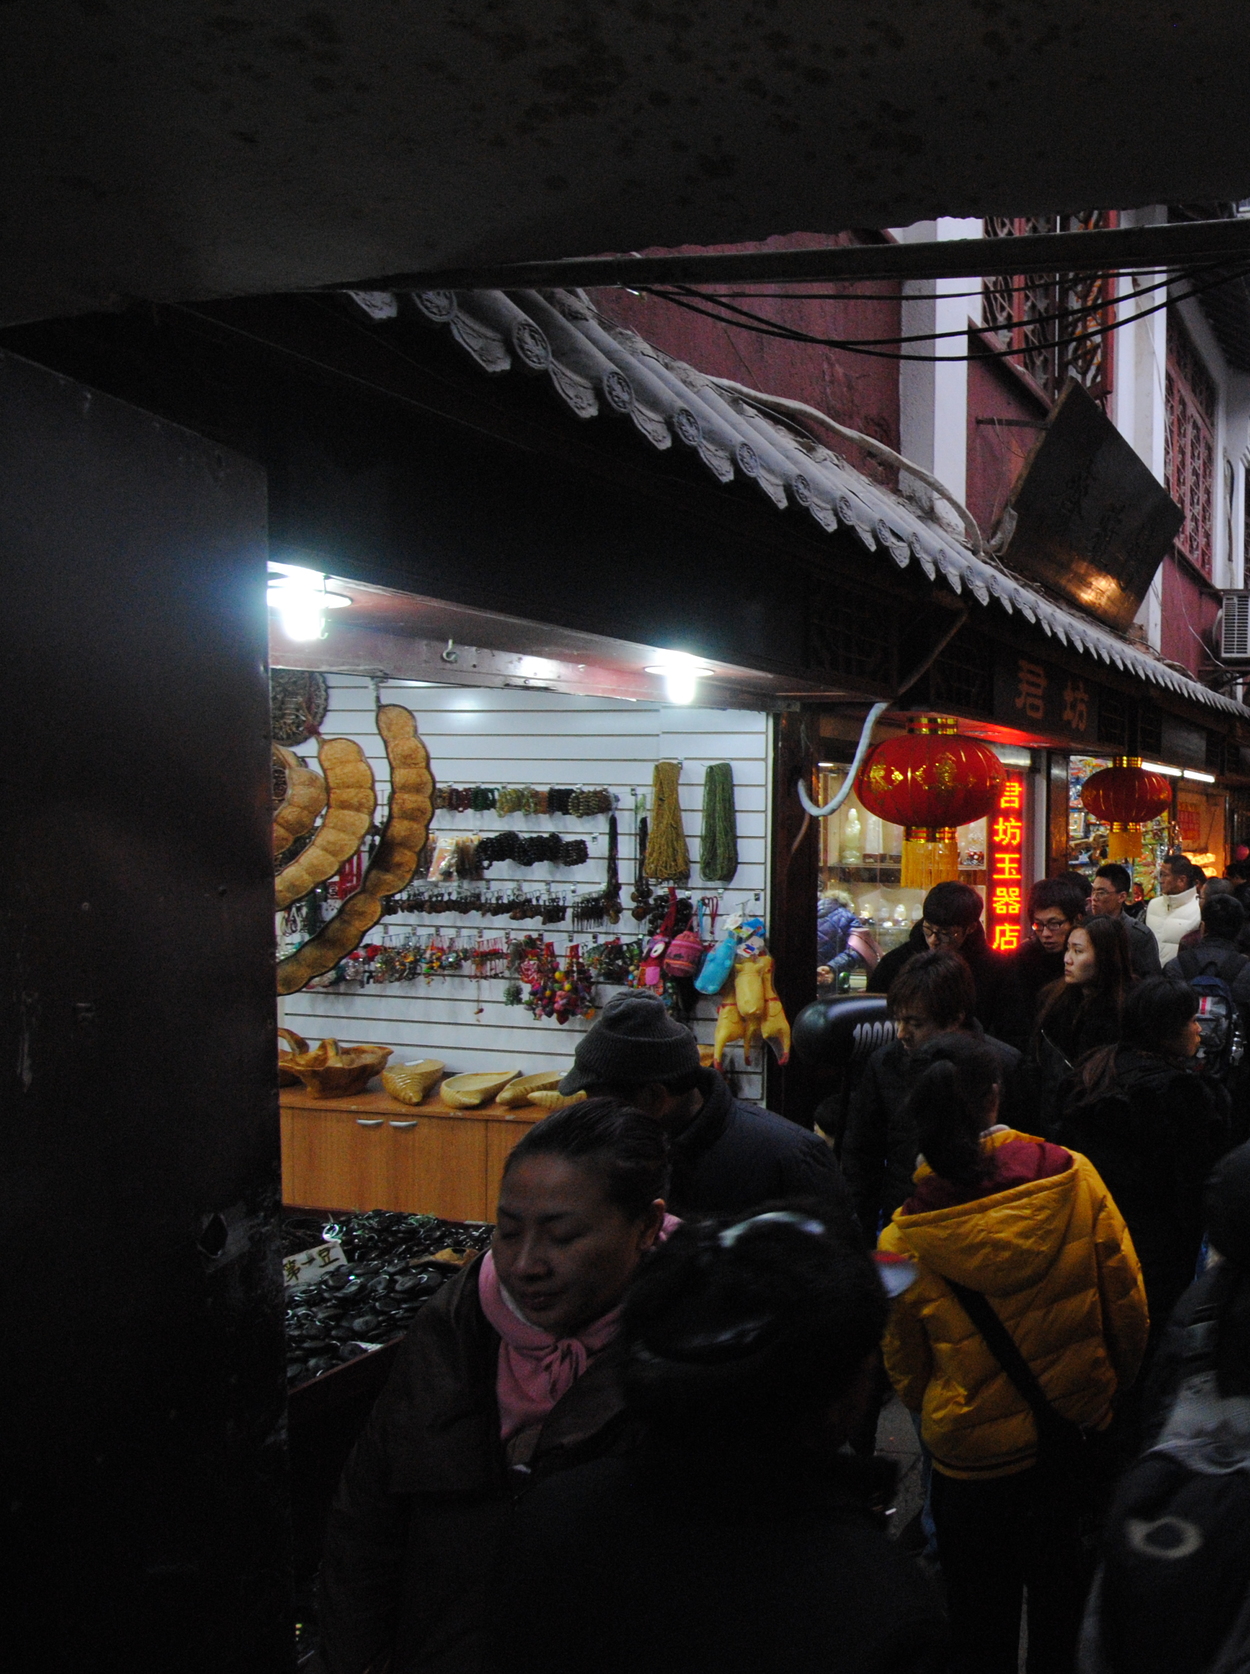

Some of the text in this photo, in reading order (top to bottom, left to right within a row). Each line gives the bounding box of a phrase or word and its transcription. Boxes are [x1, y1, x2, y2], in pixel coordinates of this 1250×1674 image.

[1015, 659, 1090, 732] 君坊
[992, 782, 1023, 950] 君坊玉器店
